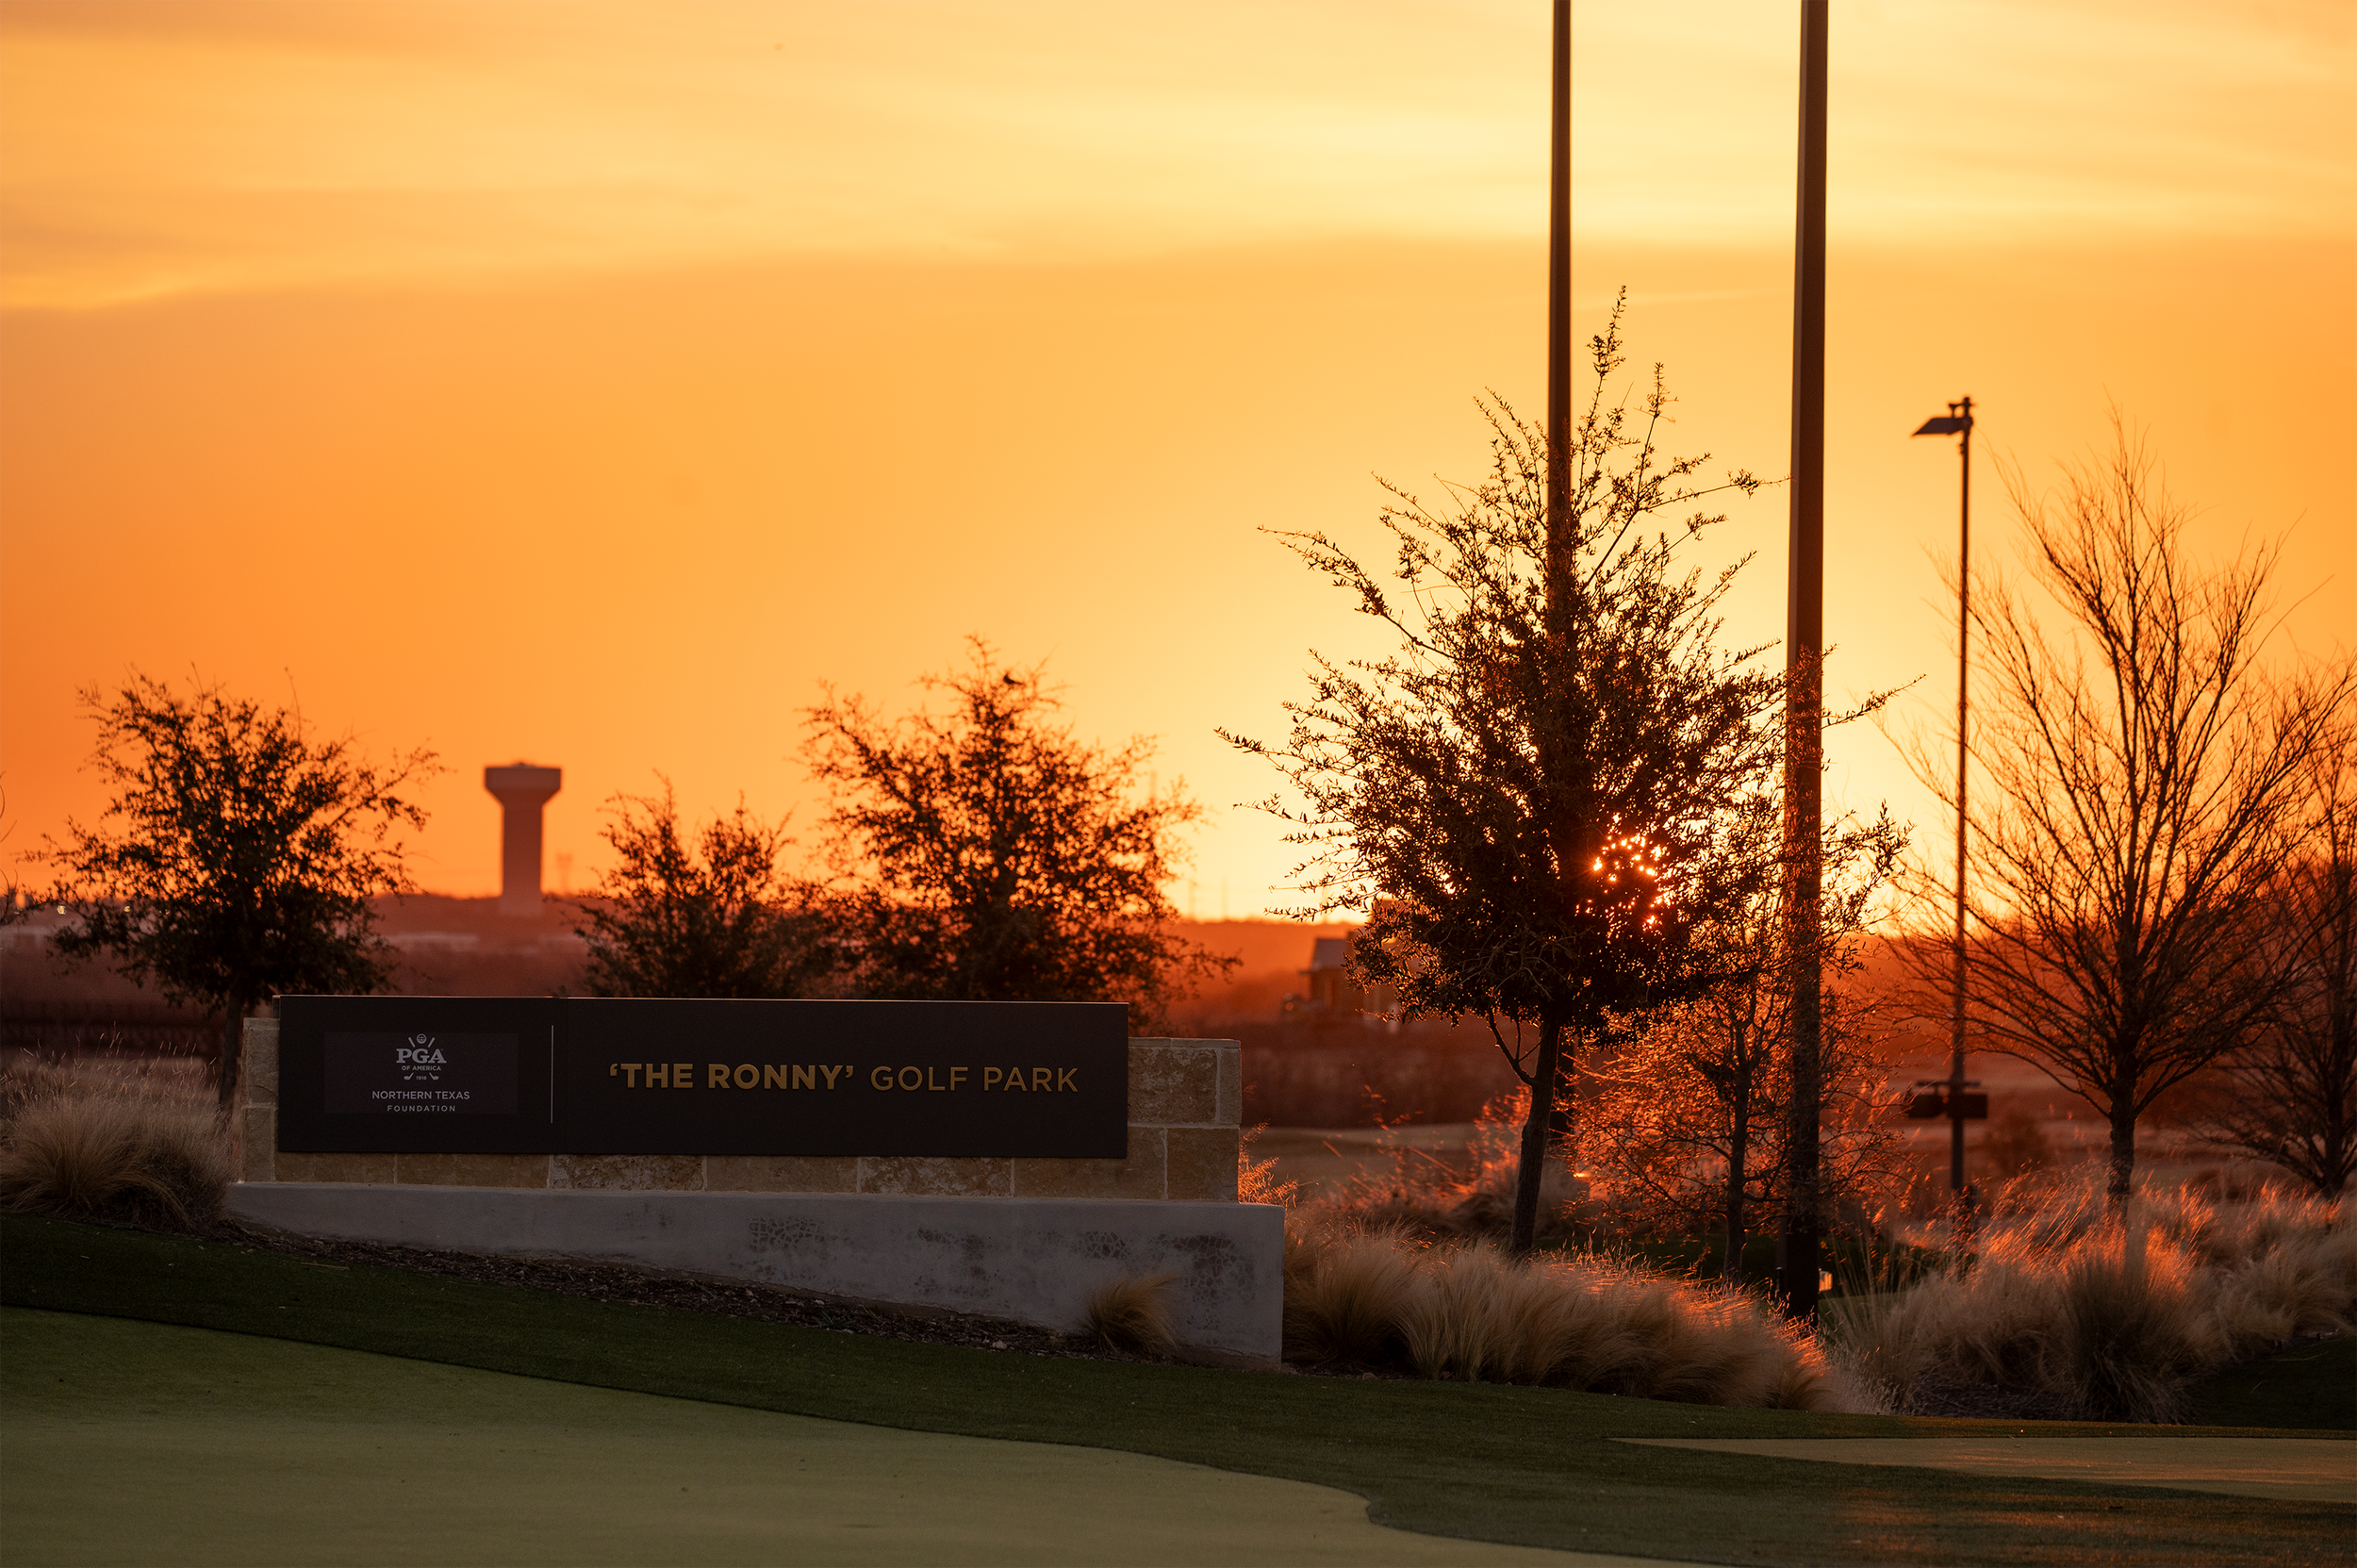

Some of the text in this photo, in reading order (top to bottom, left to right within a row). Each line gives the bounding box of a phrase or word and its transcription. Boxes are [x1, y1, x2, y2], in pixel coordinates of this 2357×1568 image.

[396, 1048, 447, 1064] PGA
[609, 1063, 1079, 1093] ‘THE RONNY’ GOLF PARK
[371, 1090, 470, 1100] NORTHERN TEXAS
[387, 1104, 456, 1113] FOUNDATION
